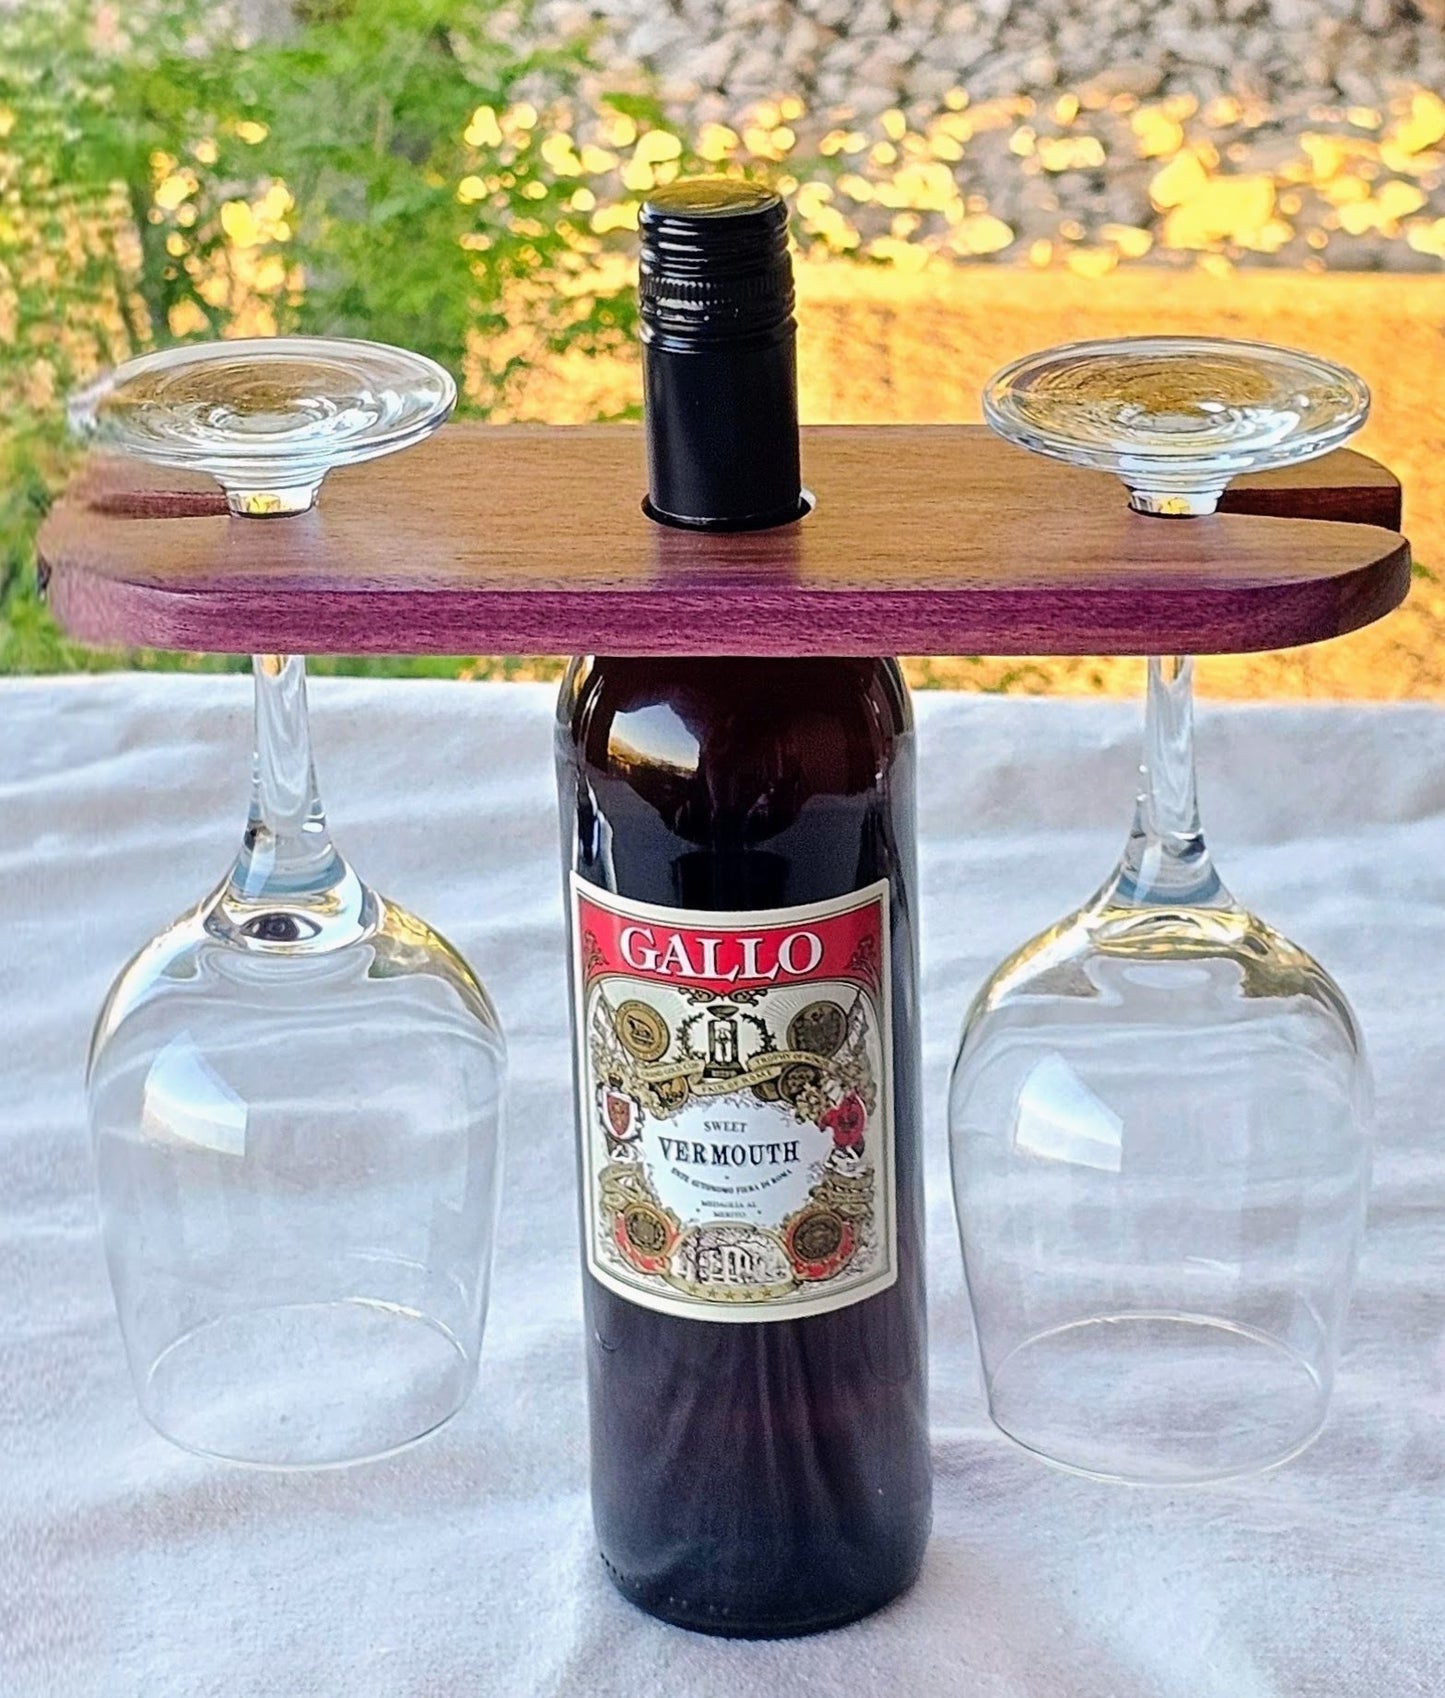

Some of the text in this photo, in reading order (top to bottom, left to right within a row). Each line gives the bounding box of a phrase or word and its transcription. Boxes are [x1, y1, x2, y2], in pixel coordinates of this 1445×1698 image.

[620, 926, 823, 982] GALLO
[702, 1070, 773, 1092] FAIR OF ROME
[704, 1120, 748, 1134] SWEET
[658, 1135, 800, 1167] VERMOUTH
[736, 1185, 760, 1195] FIERA
[761, 1180, 771, 1190] DI
[771, 1169, 793, 1184] ROMA
